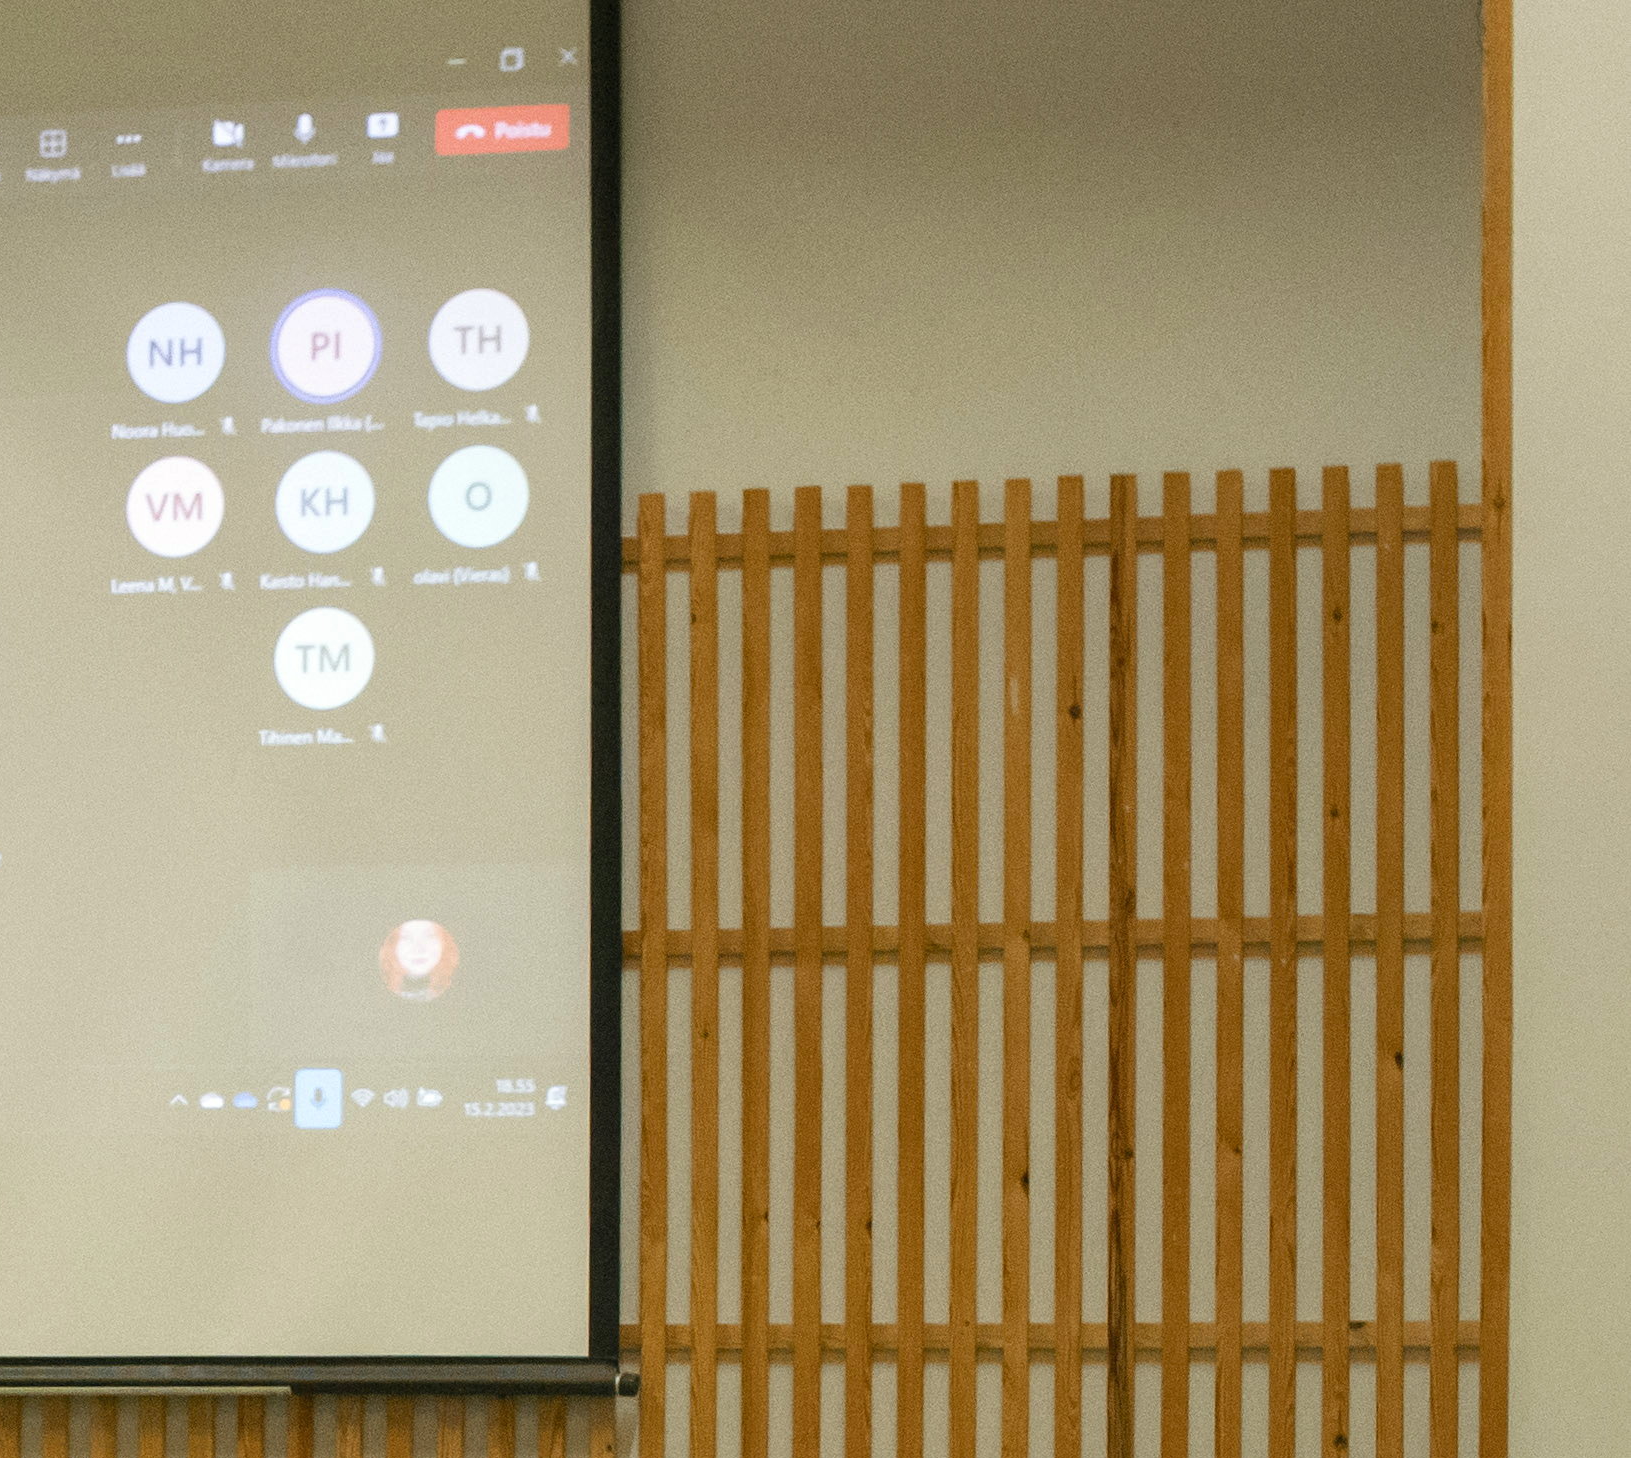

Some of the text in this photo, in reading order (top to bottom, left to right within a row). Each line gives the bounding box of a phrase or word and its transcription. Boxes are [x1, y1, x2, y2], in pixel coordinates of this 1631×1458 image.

[147, 337, 203, 369] NH
[310, 331, 341, 362] PI
[453, 325, 503, 356] TH
[145, 492, 204, 522] VM
[300, 488, 349, 518] KH
[296, 644, 351, 675] TM
